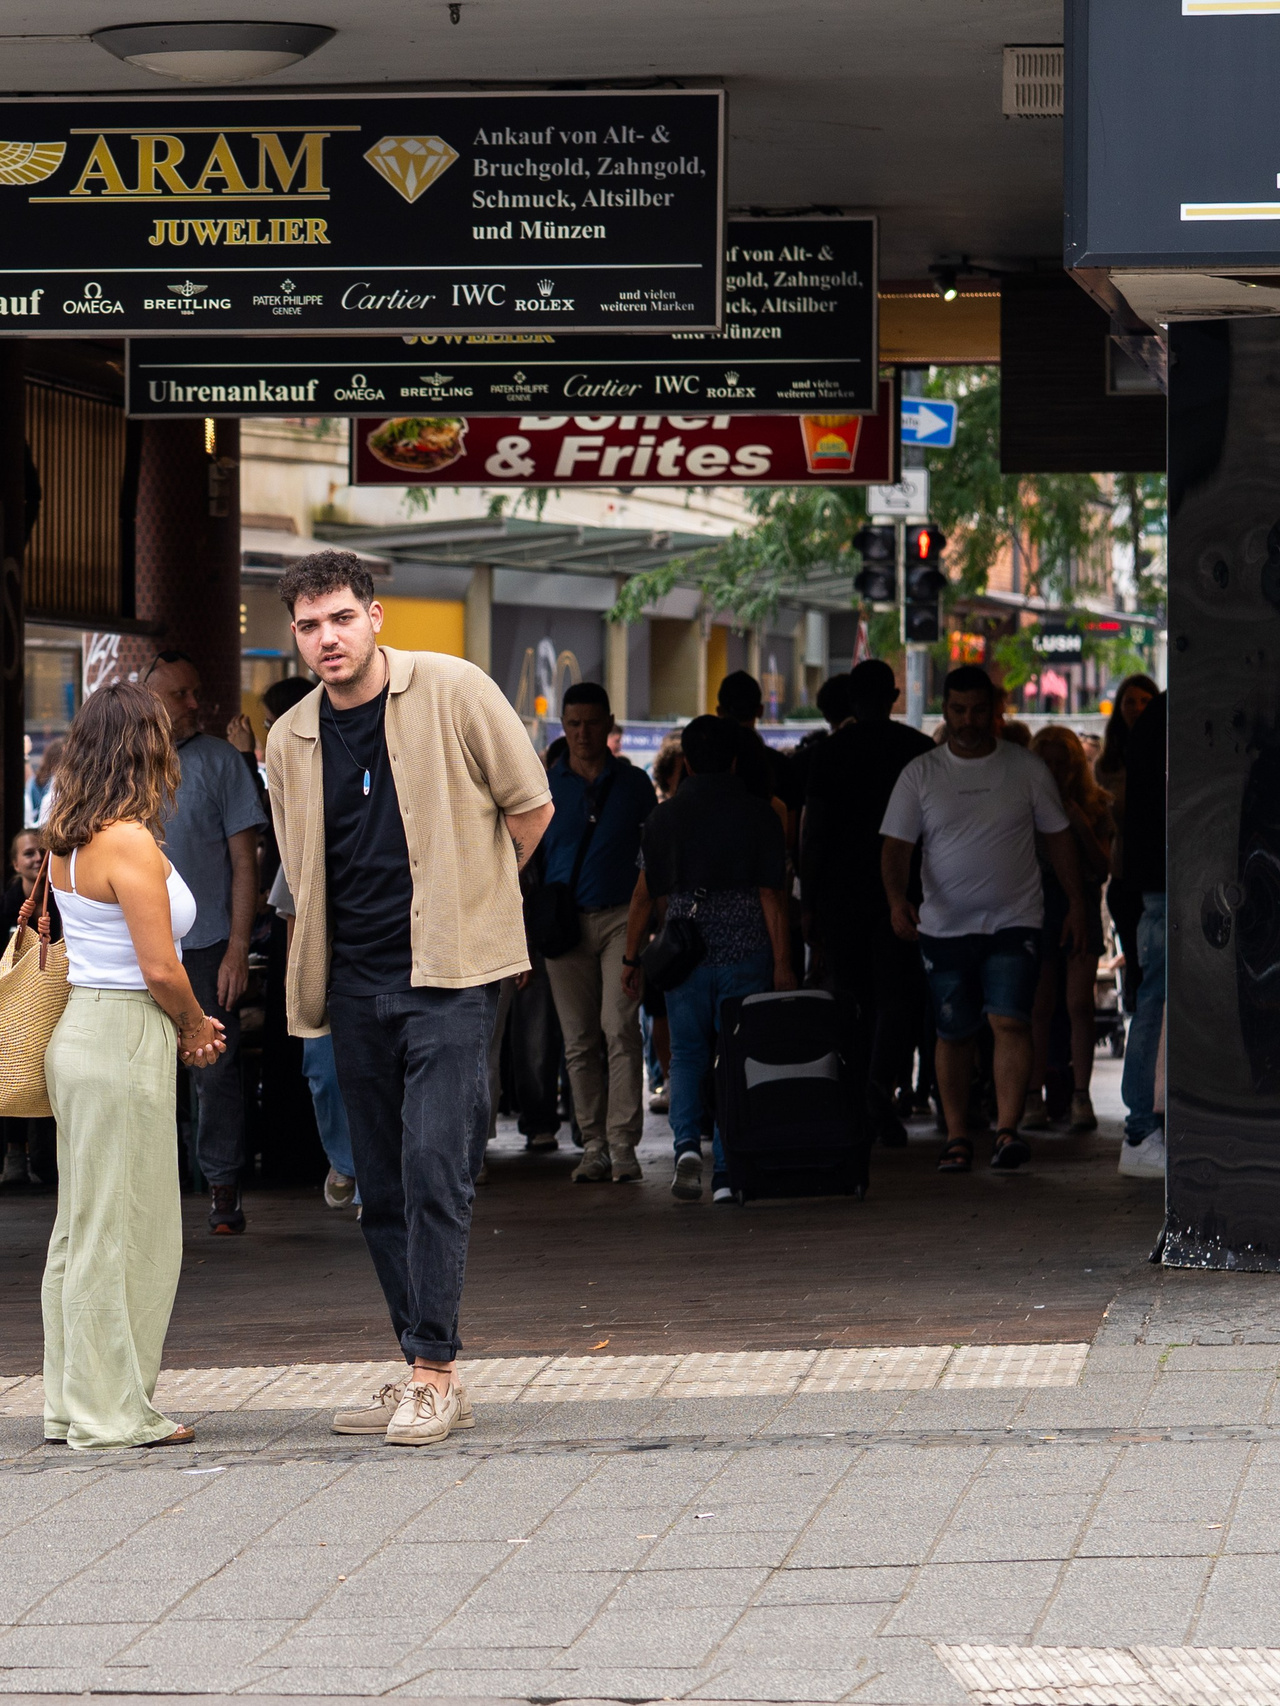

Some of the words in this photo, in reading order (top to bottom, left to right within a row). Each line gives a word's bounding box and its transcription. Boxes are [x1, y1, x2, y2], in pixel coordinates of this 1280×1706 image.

[473, 126, 555, 145] Ankauf
[559, 129, 597, 144] von
[603, 125, 645, 144] Alt-
[650, 125, 671, 144] &
[70, 132, 331, 195] ARAM
[473, 157, 592, 182] Bruchgold,
[597, 156, 707, 180] Zahngold,
[472, 189, 577, 211] Schmuck,
[582, 189, 675, 208] Altsilber
[148, 218, 331, 247] JUWELIER
[472, 222, 513, 240] und
[520, 221, 606, 240] Münzen
[741, 249, 774, 263] von
[778, 246, 813, 262] Alt-
[817, 245, 834, 262] &
[726, 271, 769, 292] gold,
[773, 271, 864, 291] Zahngold,
[253, 296, 281, 305] PATEK
[283, 295, 323, 305] PHILIPPE
[341, 282, 436, 311] Cartier
[452, 283, 506, 307] IWC
[619, 290, 640, 301] und
[643, 290, 677, 301] vielen
[63, 300, 125, 314] OMEGA
[143, 299, 232, 310] BREITLING
[272, 307, 302, 316] GENEVE
[514, 298, 575, 312] ROLEX
[600, 301, 648, 312] weiteren
[650, 301, 695, 312] Marken
[761, 298, 838, 314] Altsilber
[148, 379, 319, 403] Uhrenankauf
[400, 387, 474, 398] BREITLING
[490, 385, 515, 394] PATEK
[516, 385, 549, 394] PHILIPPE
[563, 374, 643, 398] Cartier
[655, 376, 700, 395] IWC
[706, 387, 757, 398] ROLEX
[792, 379, 810, 390] und
[334, 388, 385, 401] OMEGA
[777, 389, 816, 400] weiteren
[817, 389, 855, 399] Marken
[485, 436, 536, 478] &
[554, 436, 773, 478] Frites
